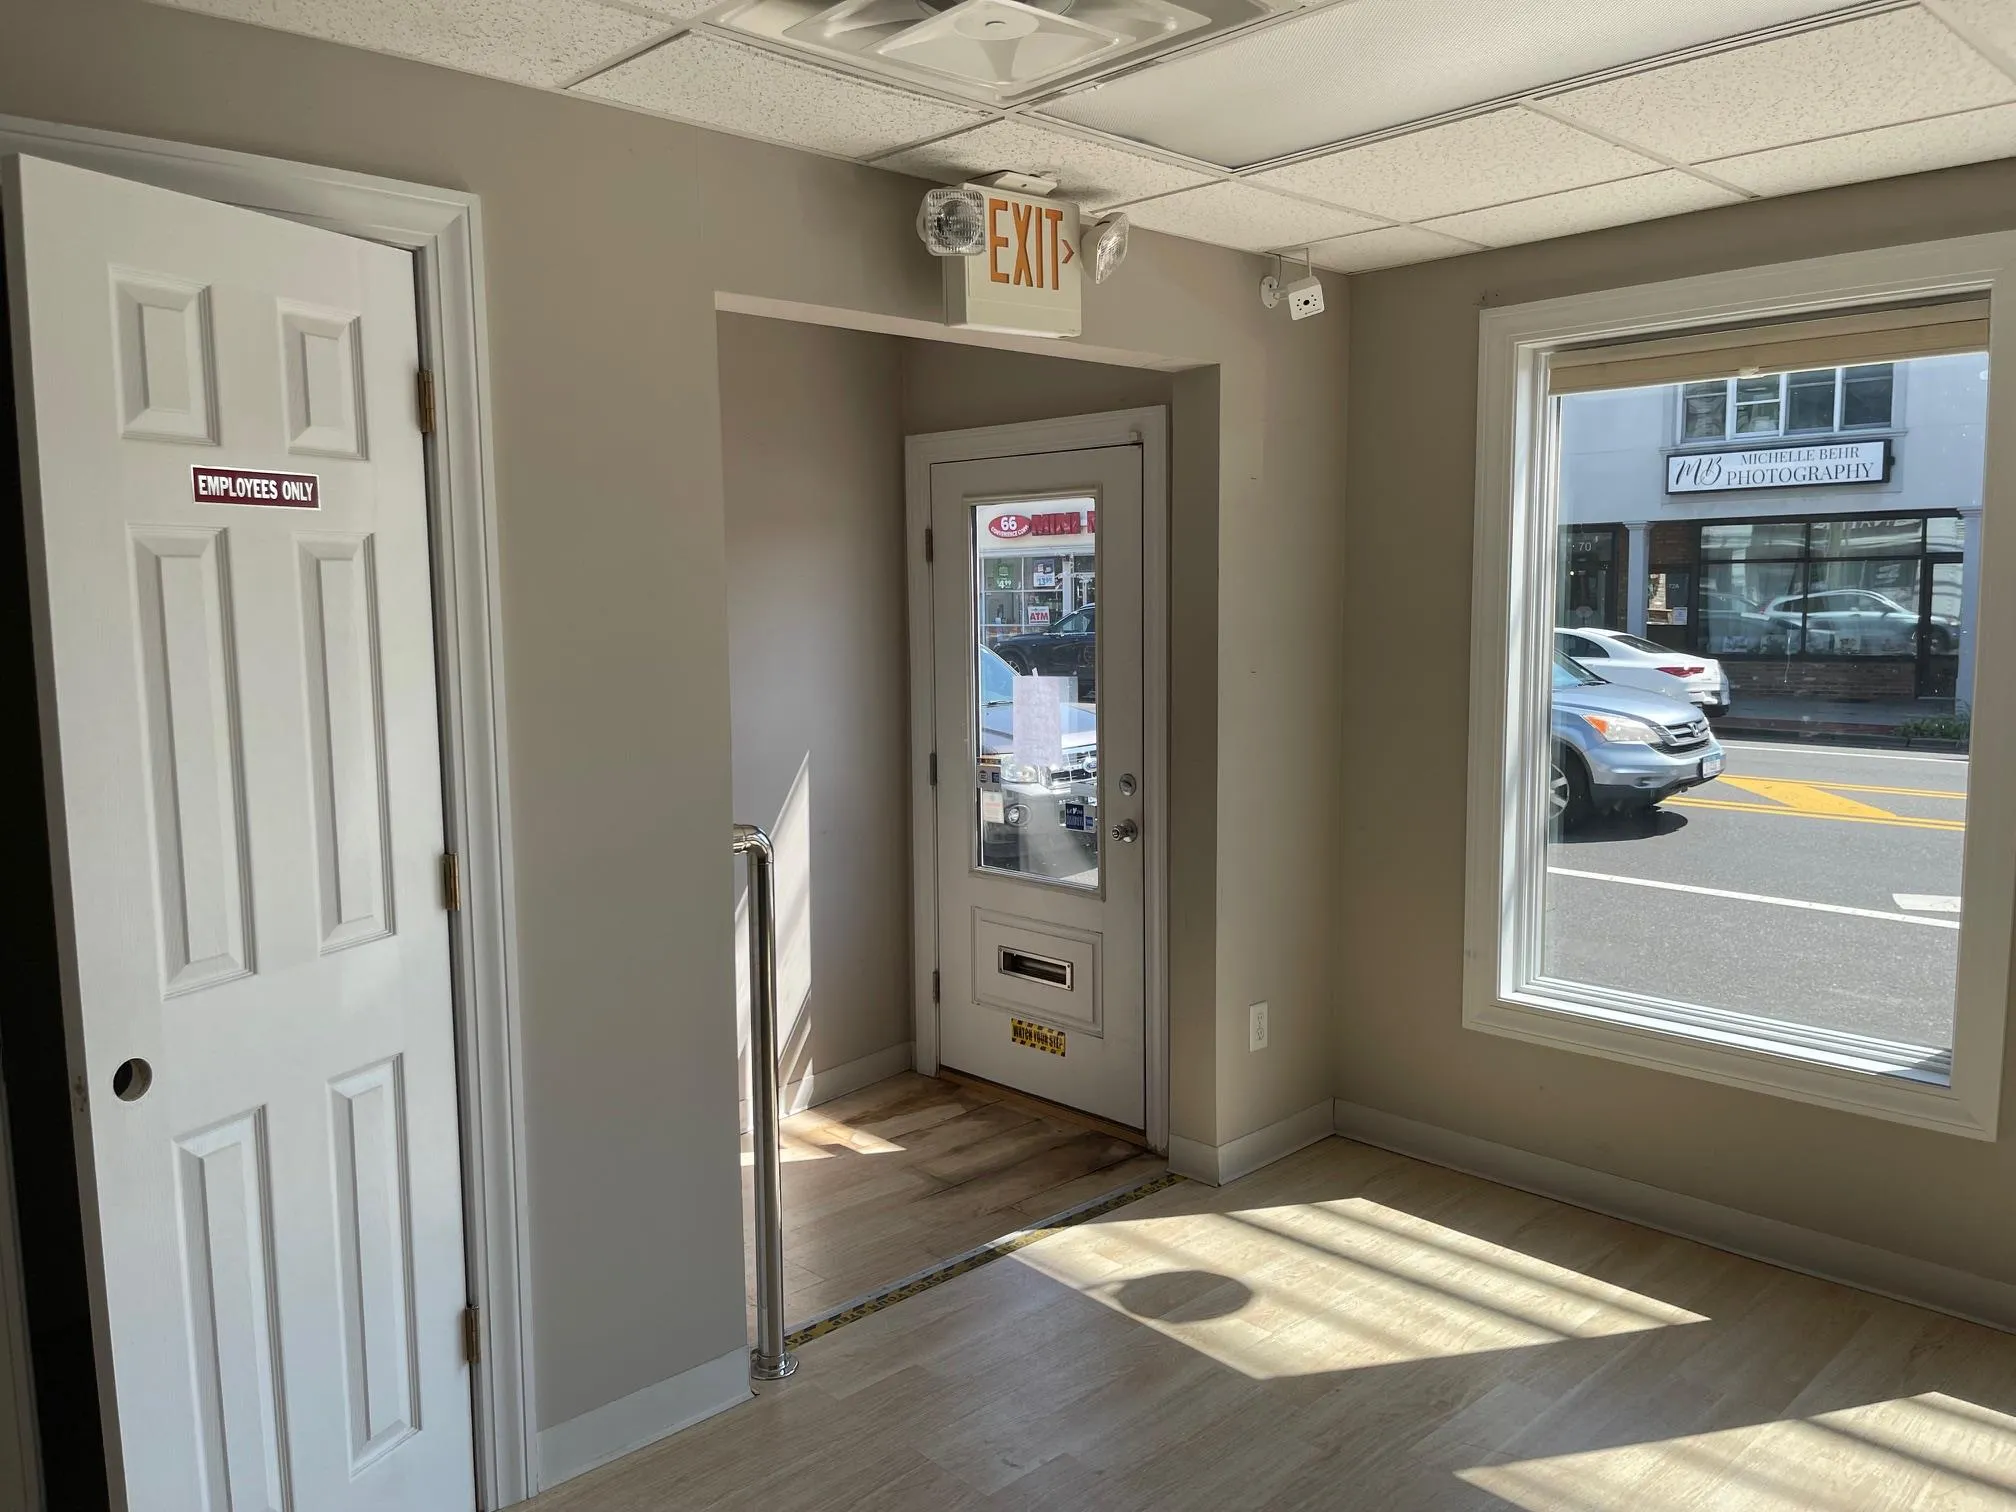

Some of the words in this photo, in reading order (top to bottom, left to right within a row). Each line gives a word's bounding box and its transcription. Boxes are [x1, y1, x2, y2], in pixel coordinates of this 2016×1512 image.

[988, 197, 1063, 291] EXIT
[1741, 449, 1815, 466] MICHELLE
[1819, 446, 1860, 461] BEHR
[1675, 456, 1722, 486] MB
[1726, 462, 1874, 486] PHOTOGRAPHY
[197, 475, 278, 500] EMPLOYEES
[282, 480, 313, 502] ONLY
[1000, 516, 1017, 531] 66
[1578, 542, 1592, 552] 70
[1030, 612, 1049, 621] ATM
[1013, 1025, 1033, 1042] WATCH
[1033, 1030, 1049, 1045] YOUR
